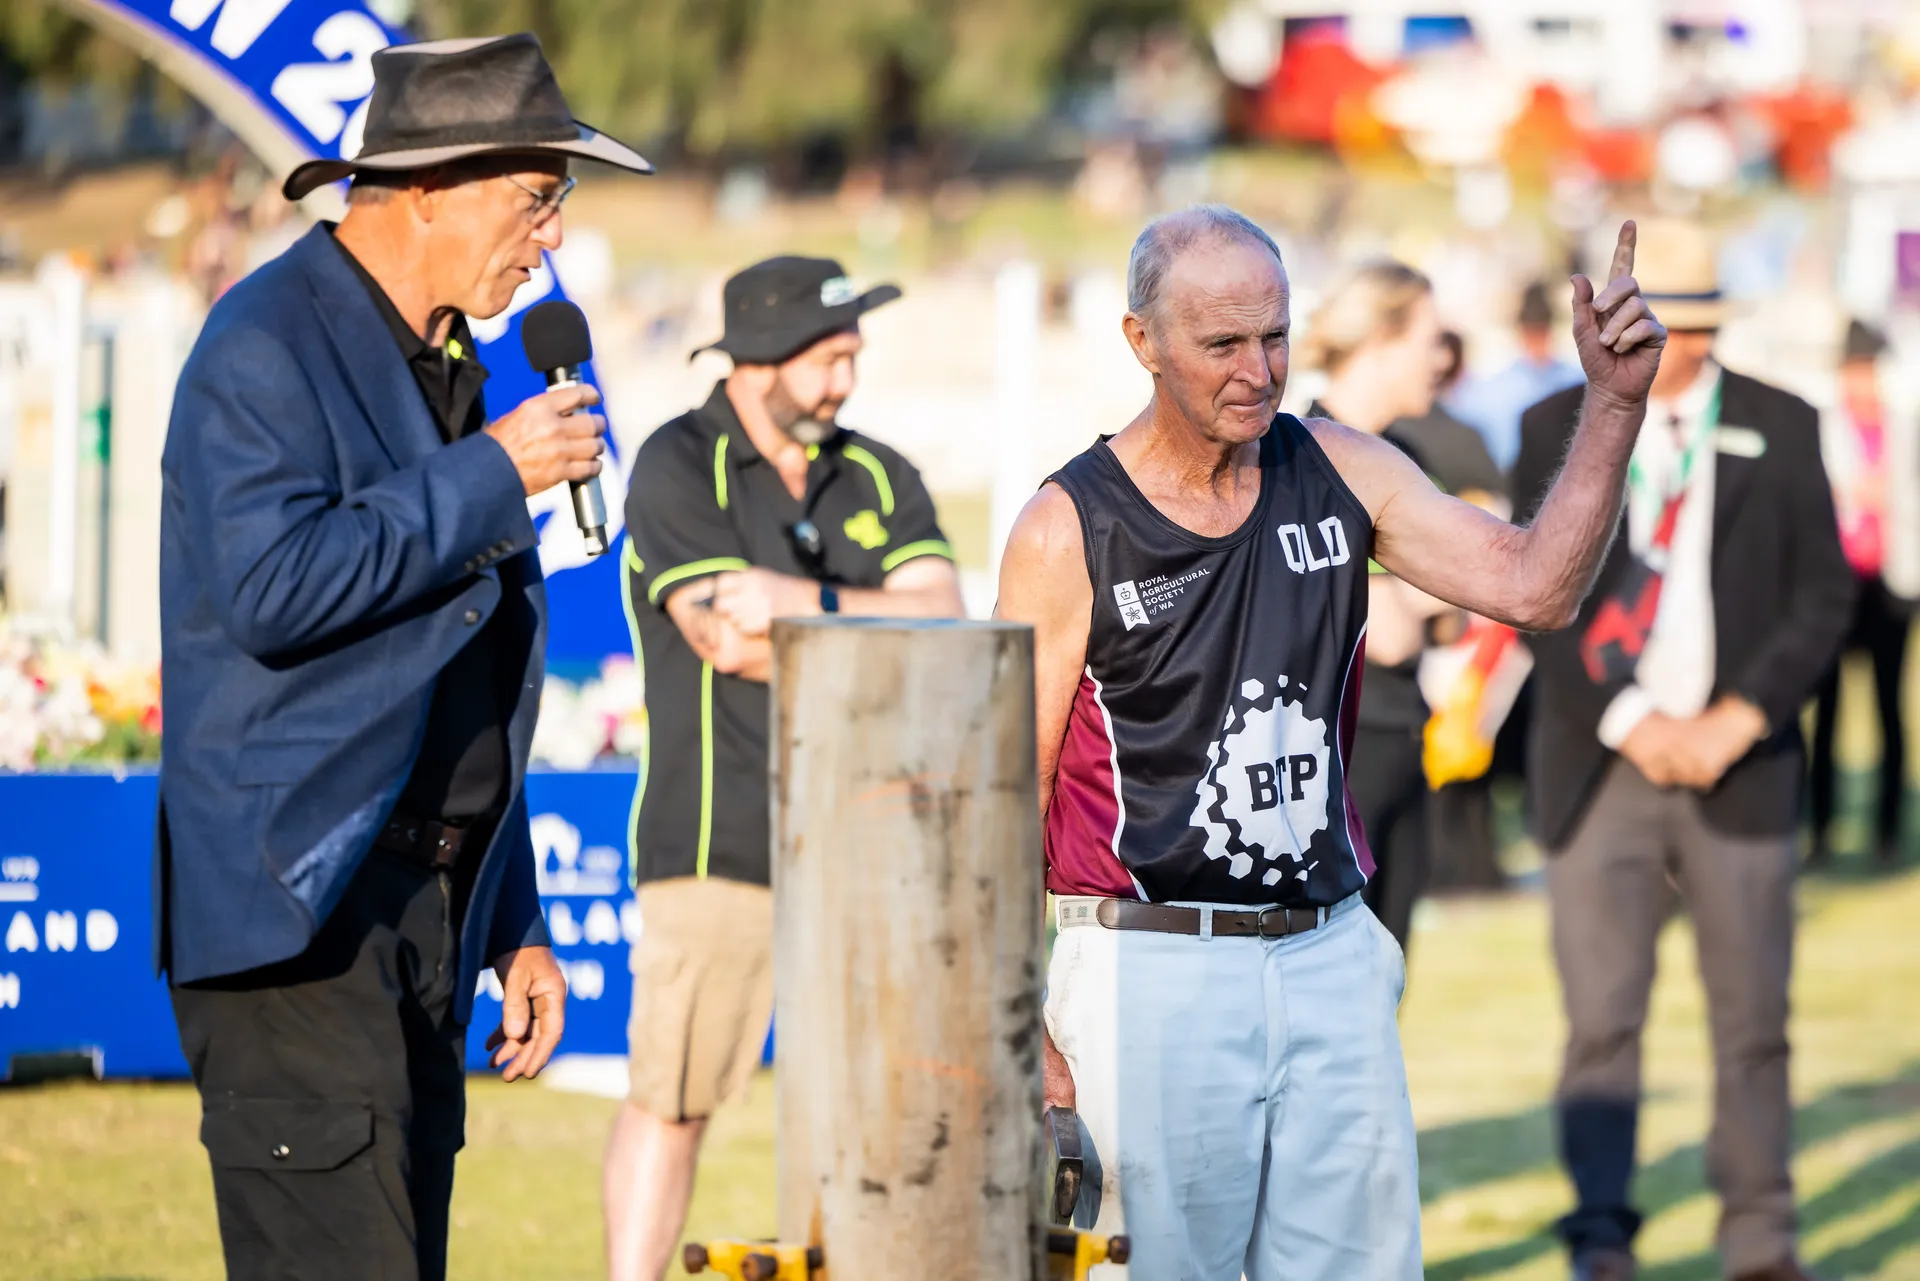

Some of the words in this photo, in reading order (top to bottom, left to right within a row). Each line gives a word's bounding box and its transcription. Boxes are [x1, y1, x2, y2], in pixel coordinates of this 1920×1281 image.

[1277, 516, 1350, 575] QLD
[1138, 574, 1169, 589] ROYAL
[1142, 568, 1210, 598] AGRICULTURAL
[1145, 587, 1185, 607] SOCIETY
[1149, 604, 1158, 616] of
[1159, 601, 1175, 611] WA
[1244, 753, 1318, 813] BTP
